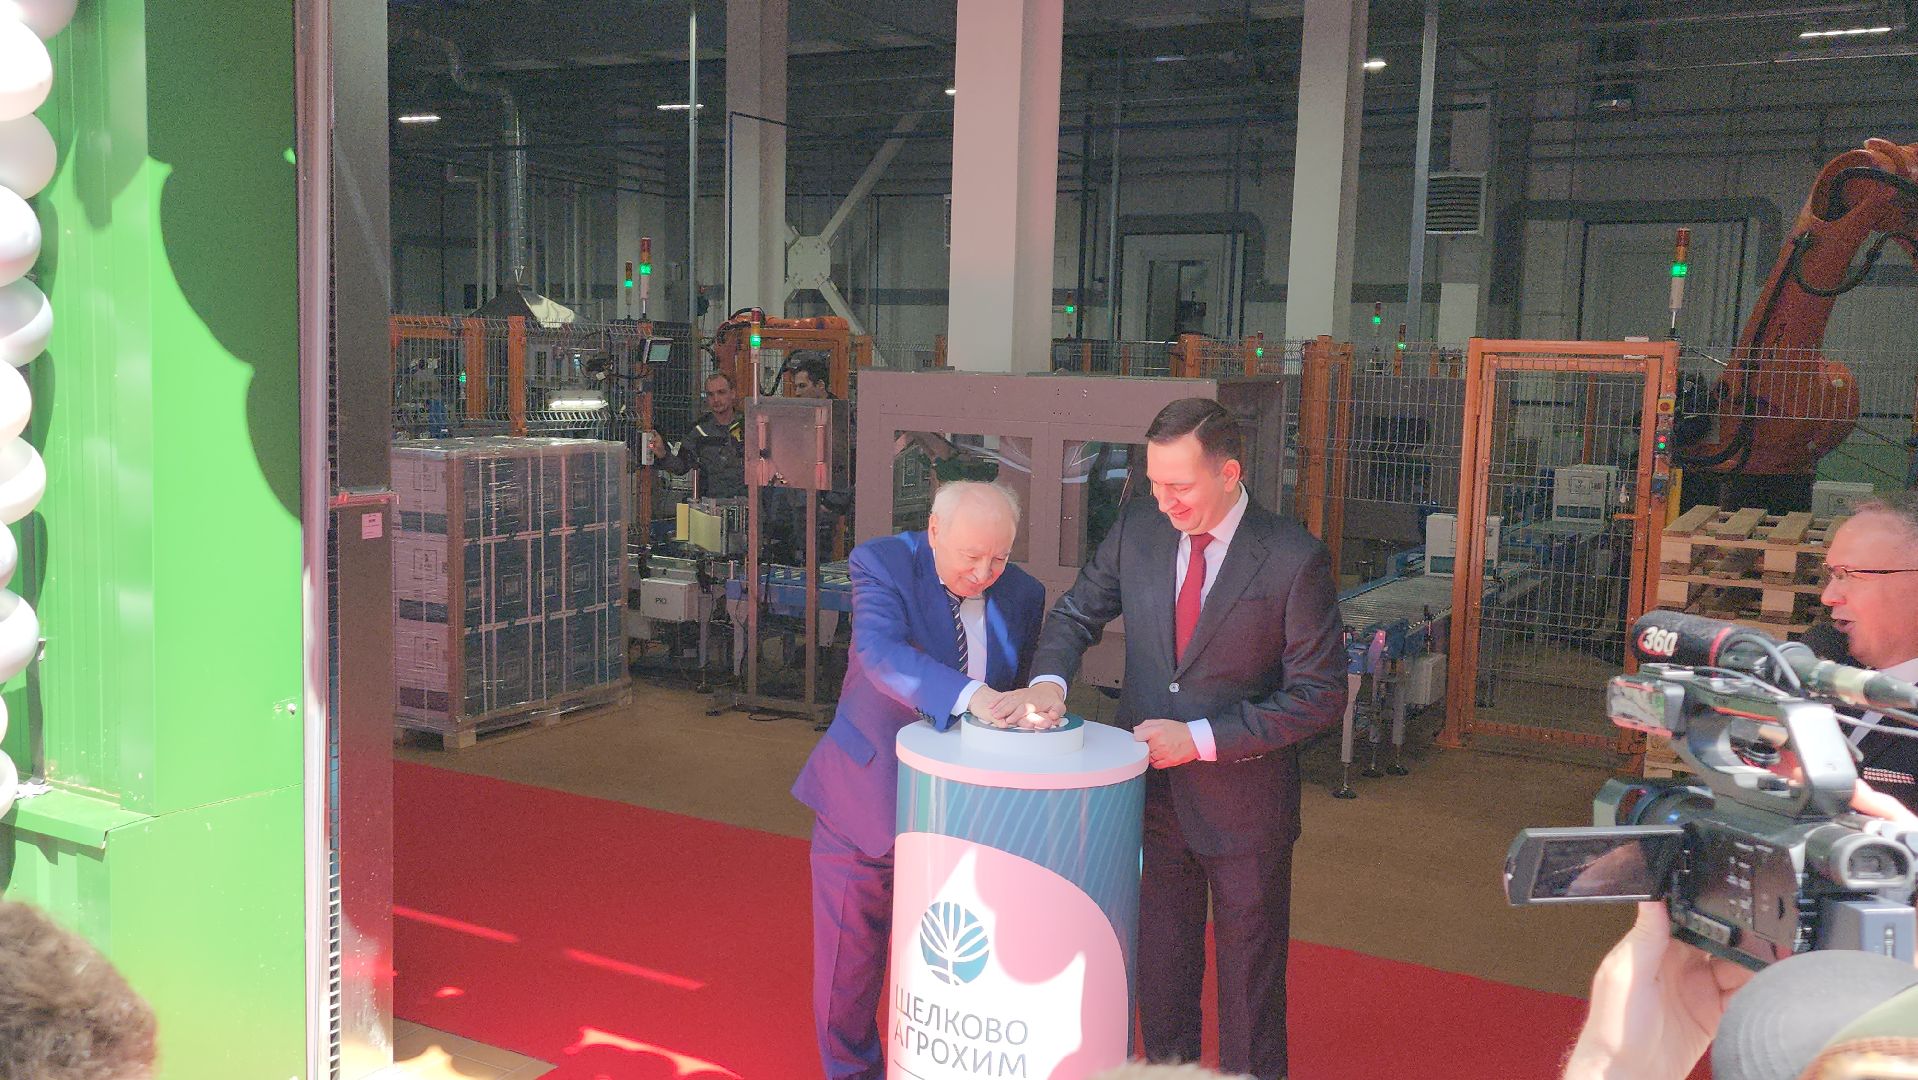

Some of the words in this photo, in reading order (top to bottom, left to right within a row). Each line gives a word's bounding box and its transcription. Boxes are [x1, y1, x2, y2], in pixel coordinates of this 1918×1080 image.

[1643, 626, 1678, 657] 360
[895, 983, 1029, 1046] ЩЕЛКОВО
[894, 1018, 1027, 1079] АГРОХИМ
